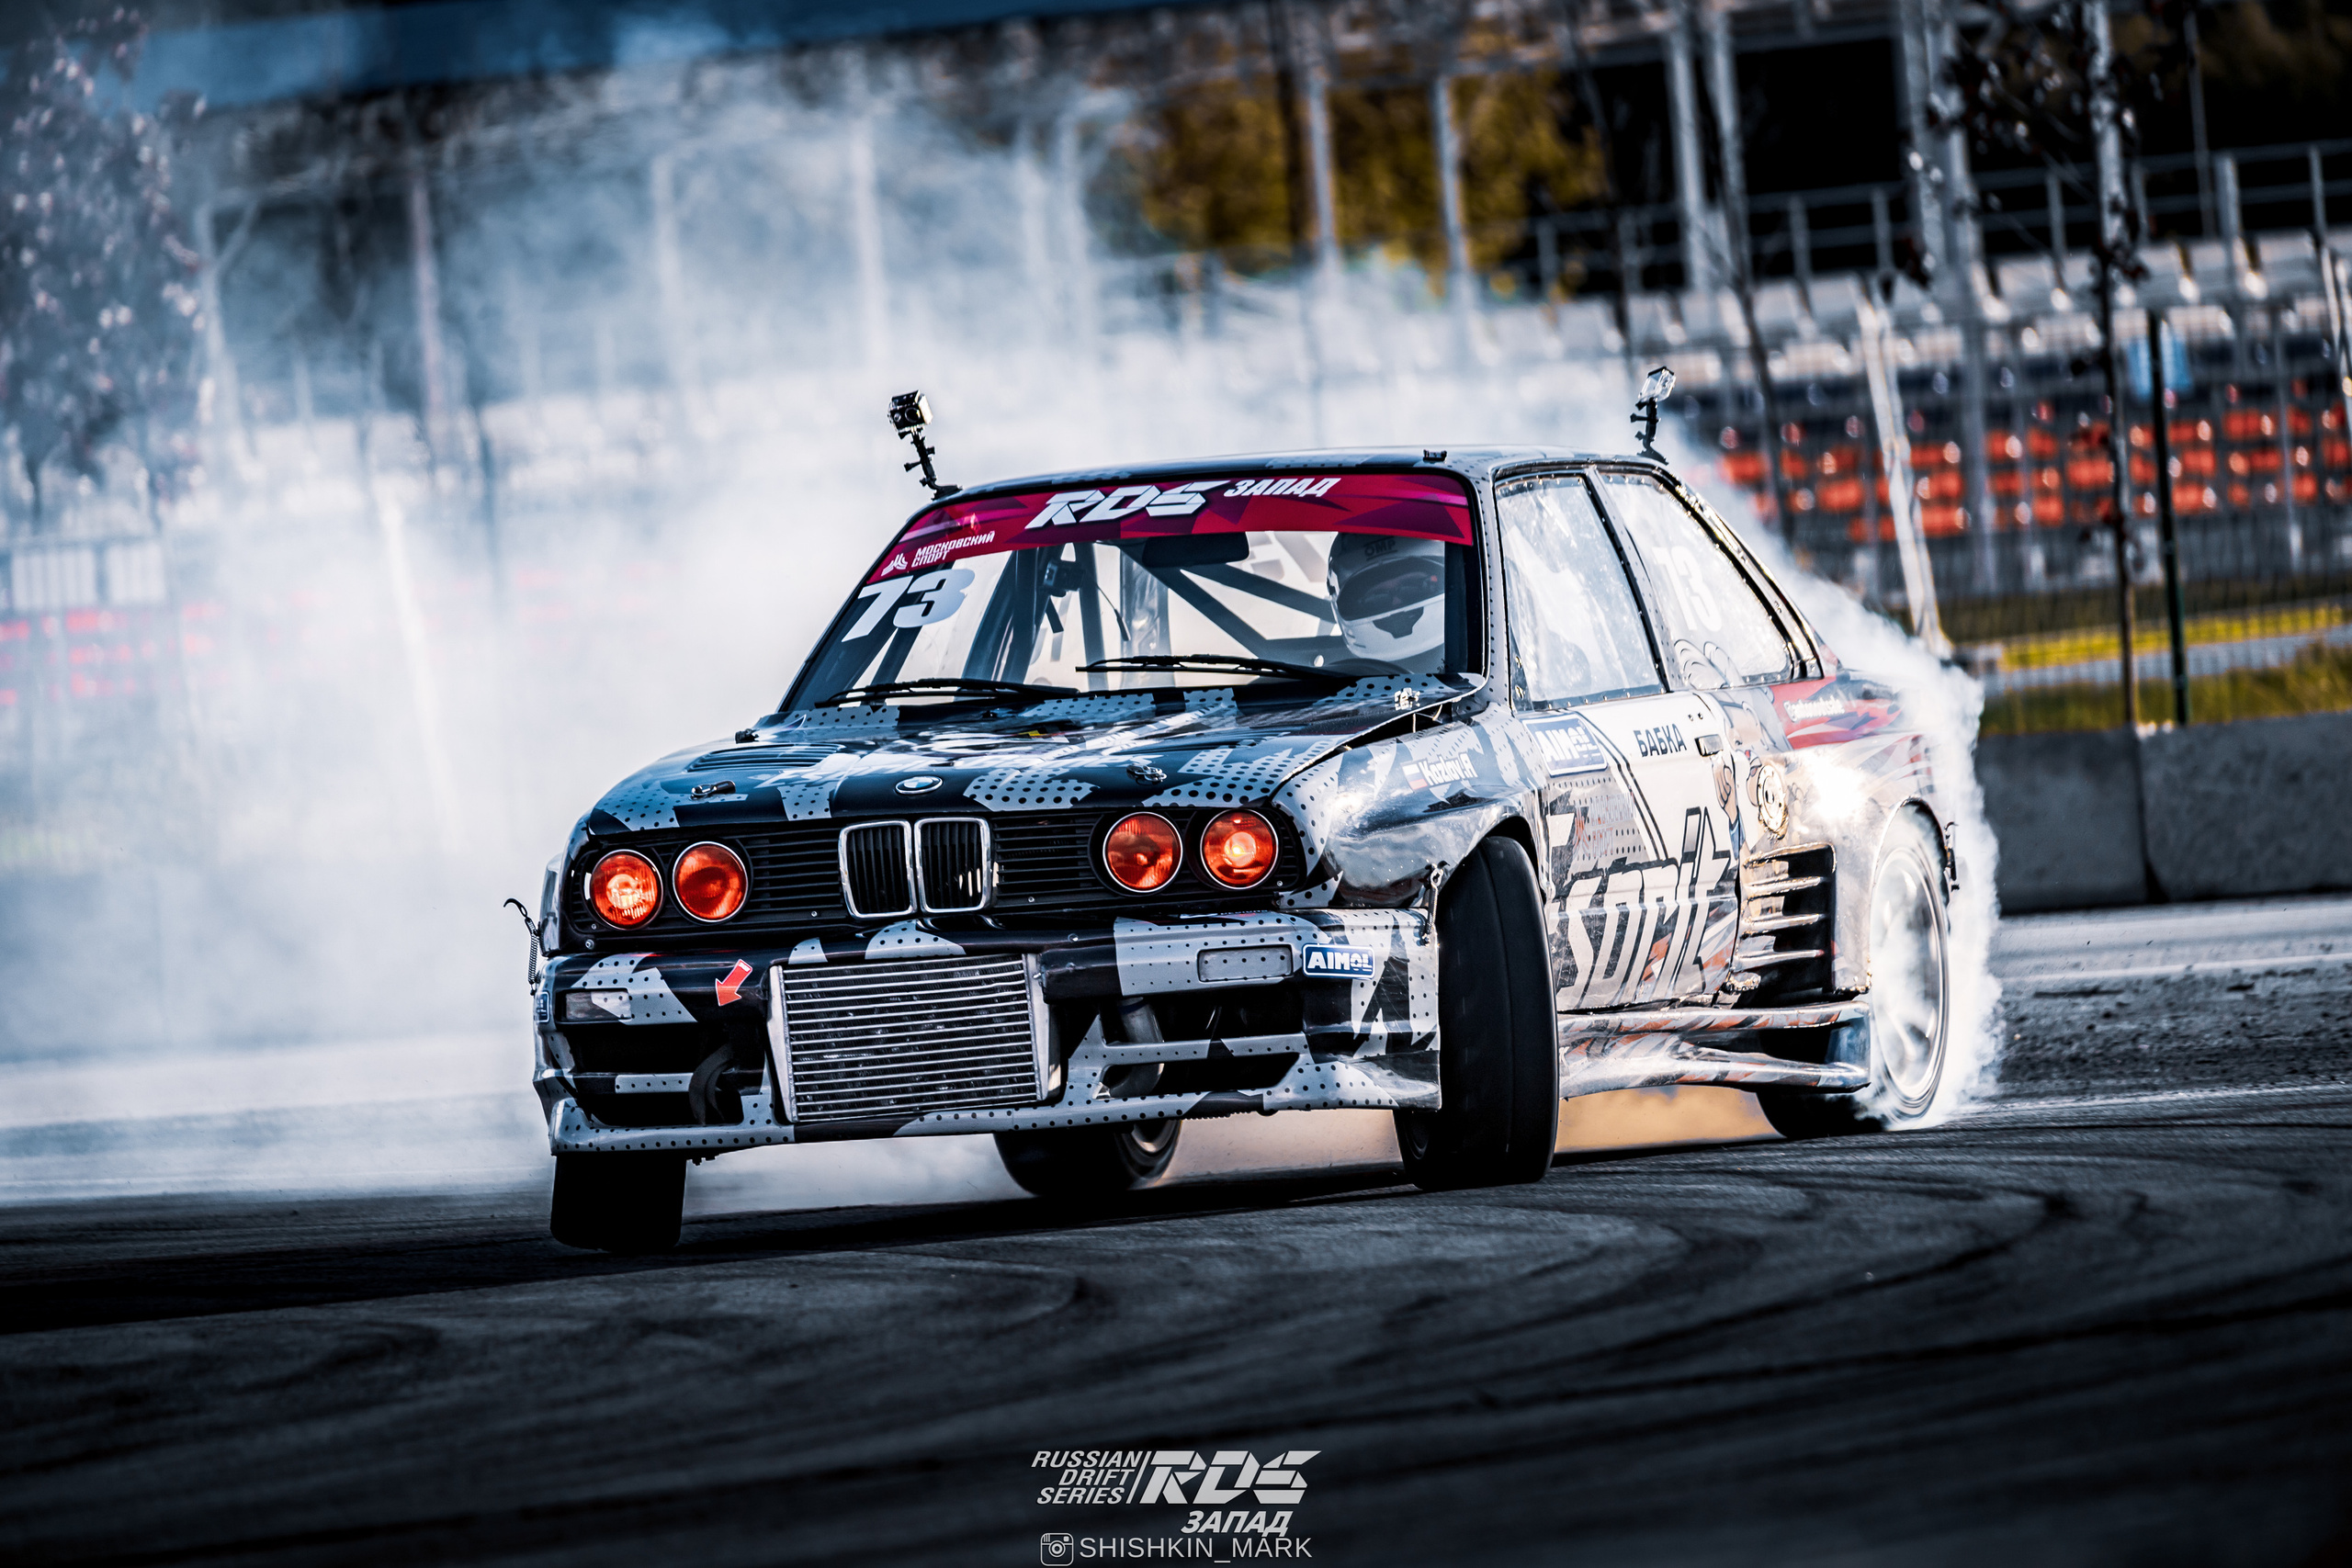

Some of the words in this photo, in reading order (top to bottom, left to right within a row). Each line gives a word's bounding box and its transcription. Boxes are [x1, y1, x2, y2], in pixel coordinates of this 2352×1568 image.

[1224, 478, 1341, 497] ЗАПАД
[1024, 480, 1230, 529] RDS
[915, 530, 996, 558] МОСКОВСКИЙ
[1364, 539, 1396, 557] OMP
[911, 551, 950, 568] СПОРТ
[1652, 546, 1722, 632] 73
[842, 569, 976, 642] 73
[1534, 726, 1600, 762] AIMOL
[1634, 724, 1688, 757] БАБКА
[1307, 951, 1373, 972] AIMOL
